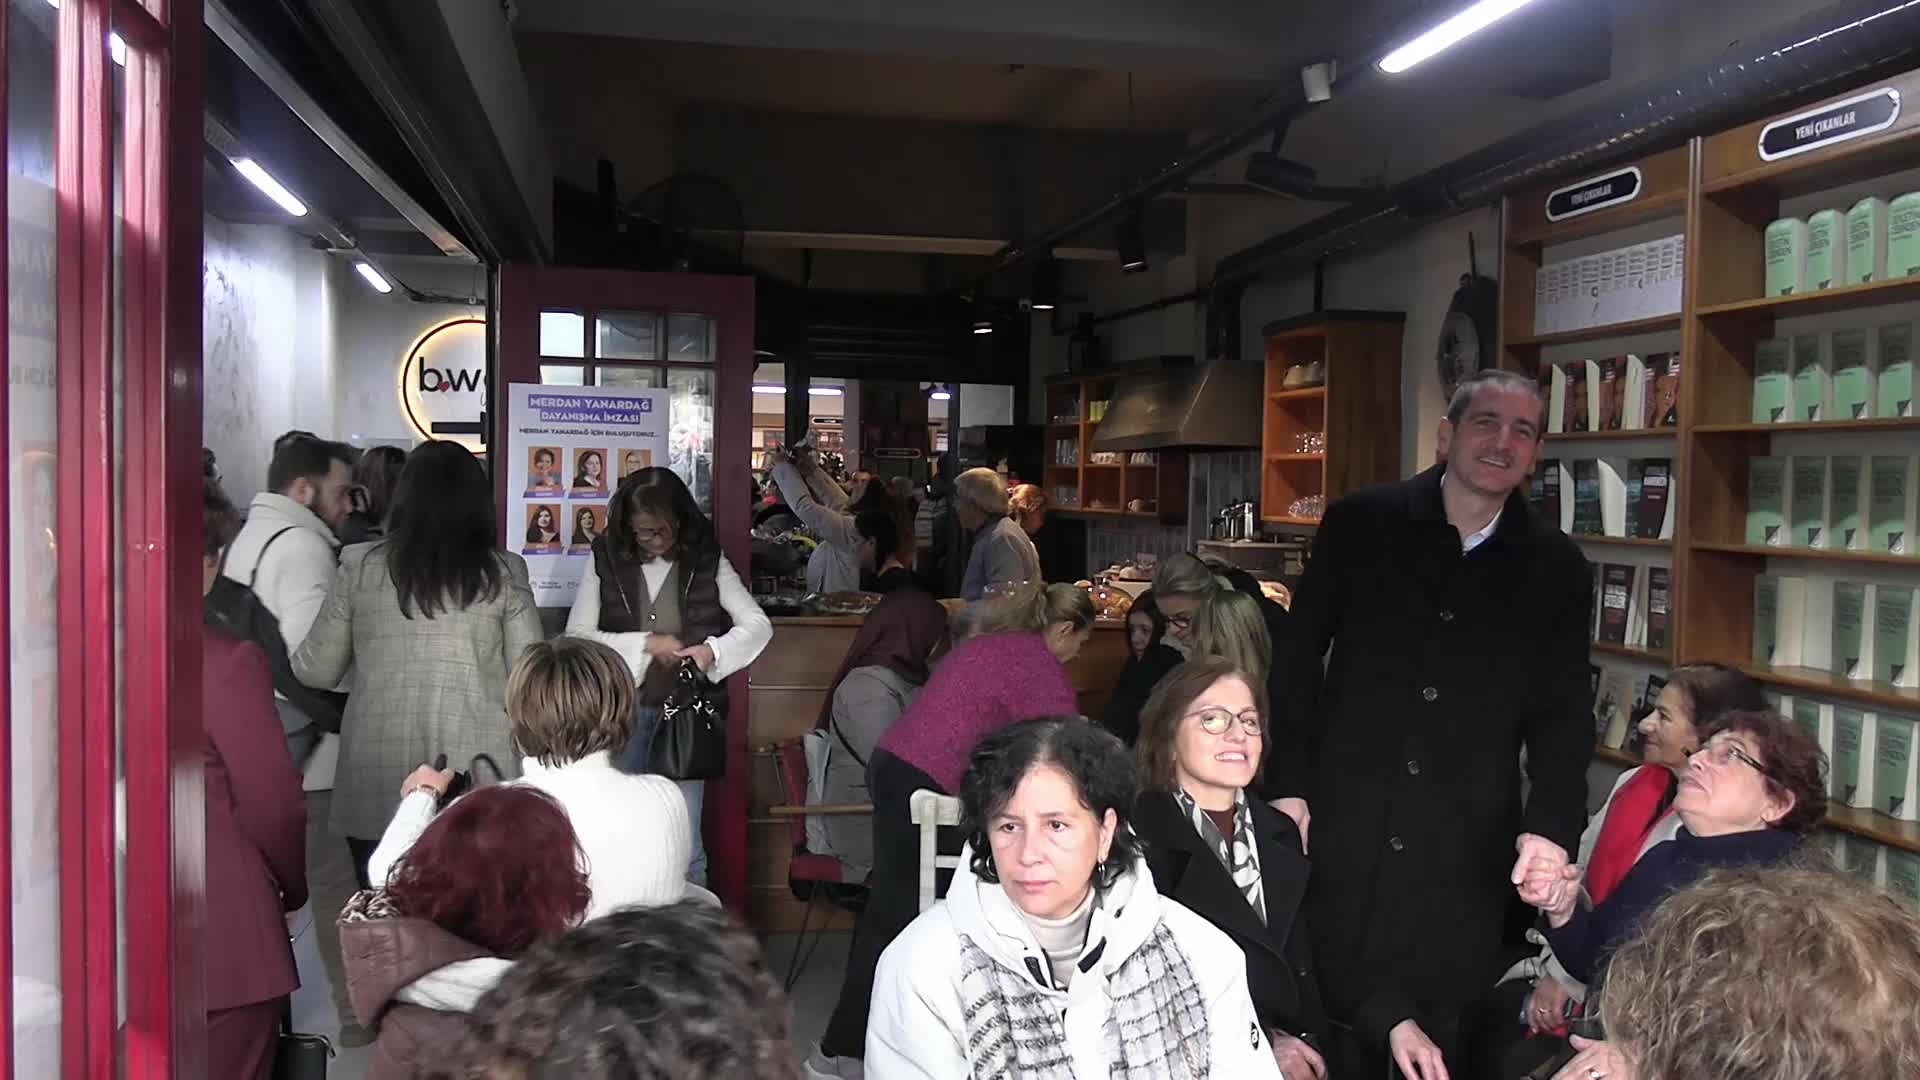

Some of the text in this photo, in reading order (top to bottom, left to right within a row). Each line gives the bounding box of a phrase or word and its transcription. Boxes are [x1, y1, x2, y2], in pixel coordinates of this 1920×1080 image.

[1795, 111, 1855, 139] YENİ ÇIKANLAR
[530, 397, 650, 410] MERDAN YANARDAĞ
[603, 411, 639, 422] İMZASI
[551, 428, 589, 436] YANARDAĞ
